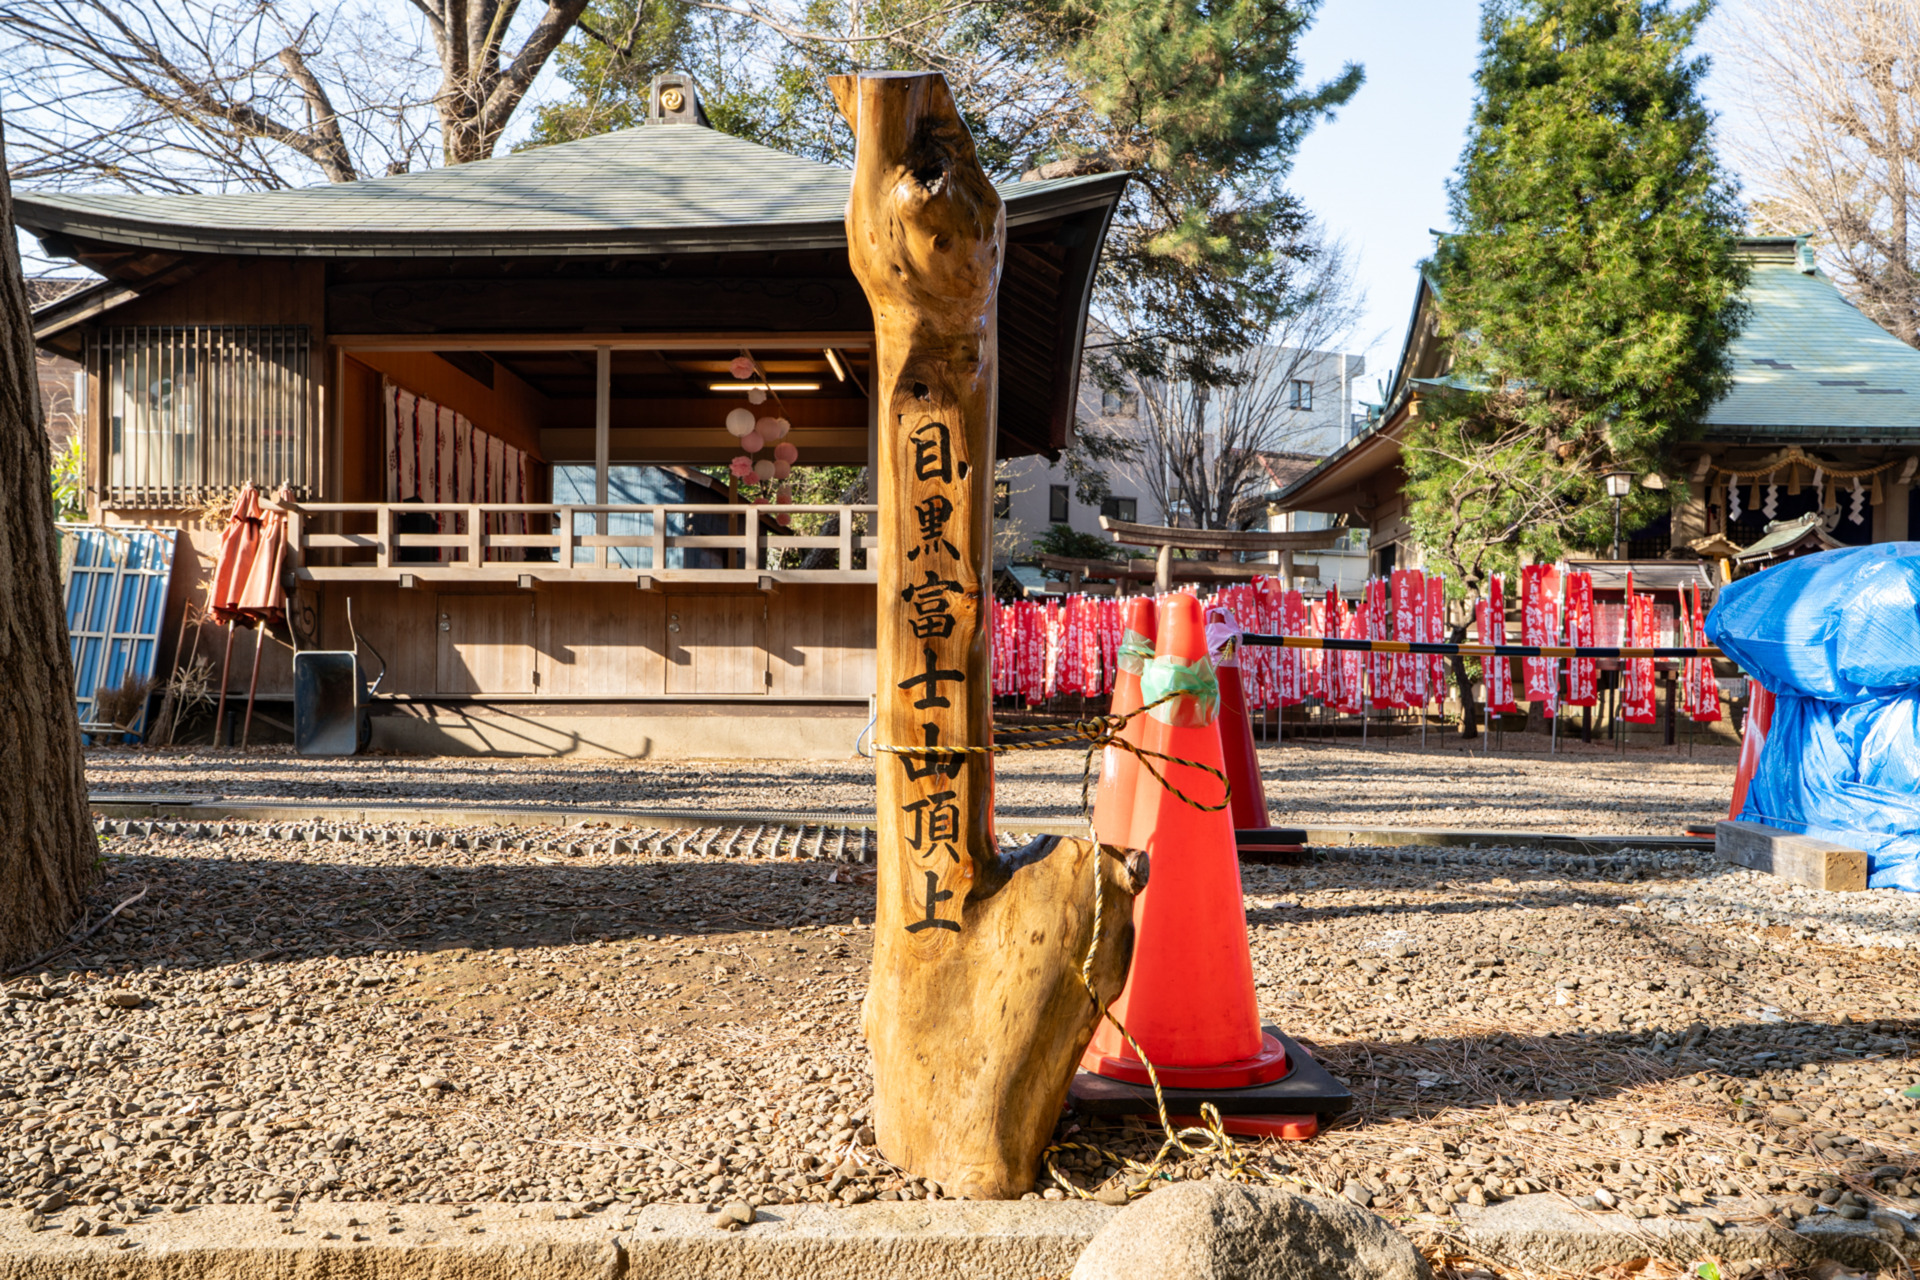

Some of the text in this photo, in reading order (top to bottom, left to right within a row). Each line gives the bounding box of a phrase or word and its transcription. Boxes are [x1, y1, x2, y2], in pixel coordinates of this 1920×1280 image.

[898, 421, 966, 934] 目黒富士山頂上
